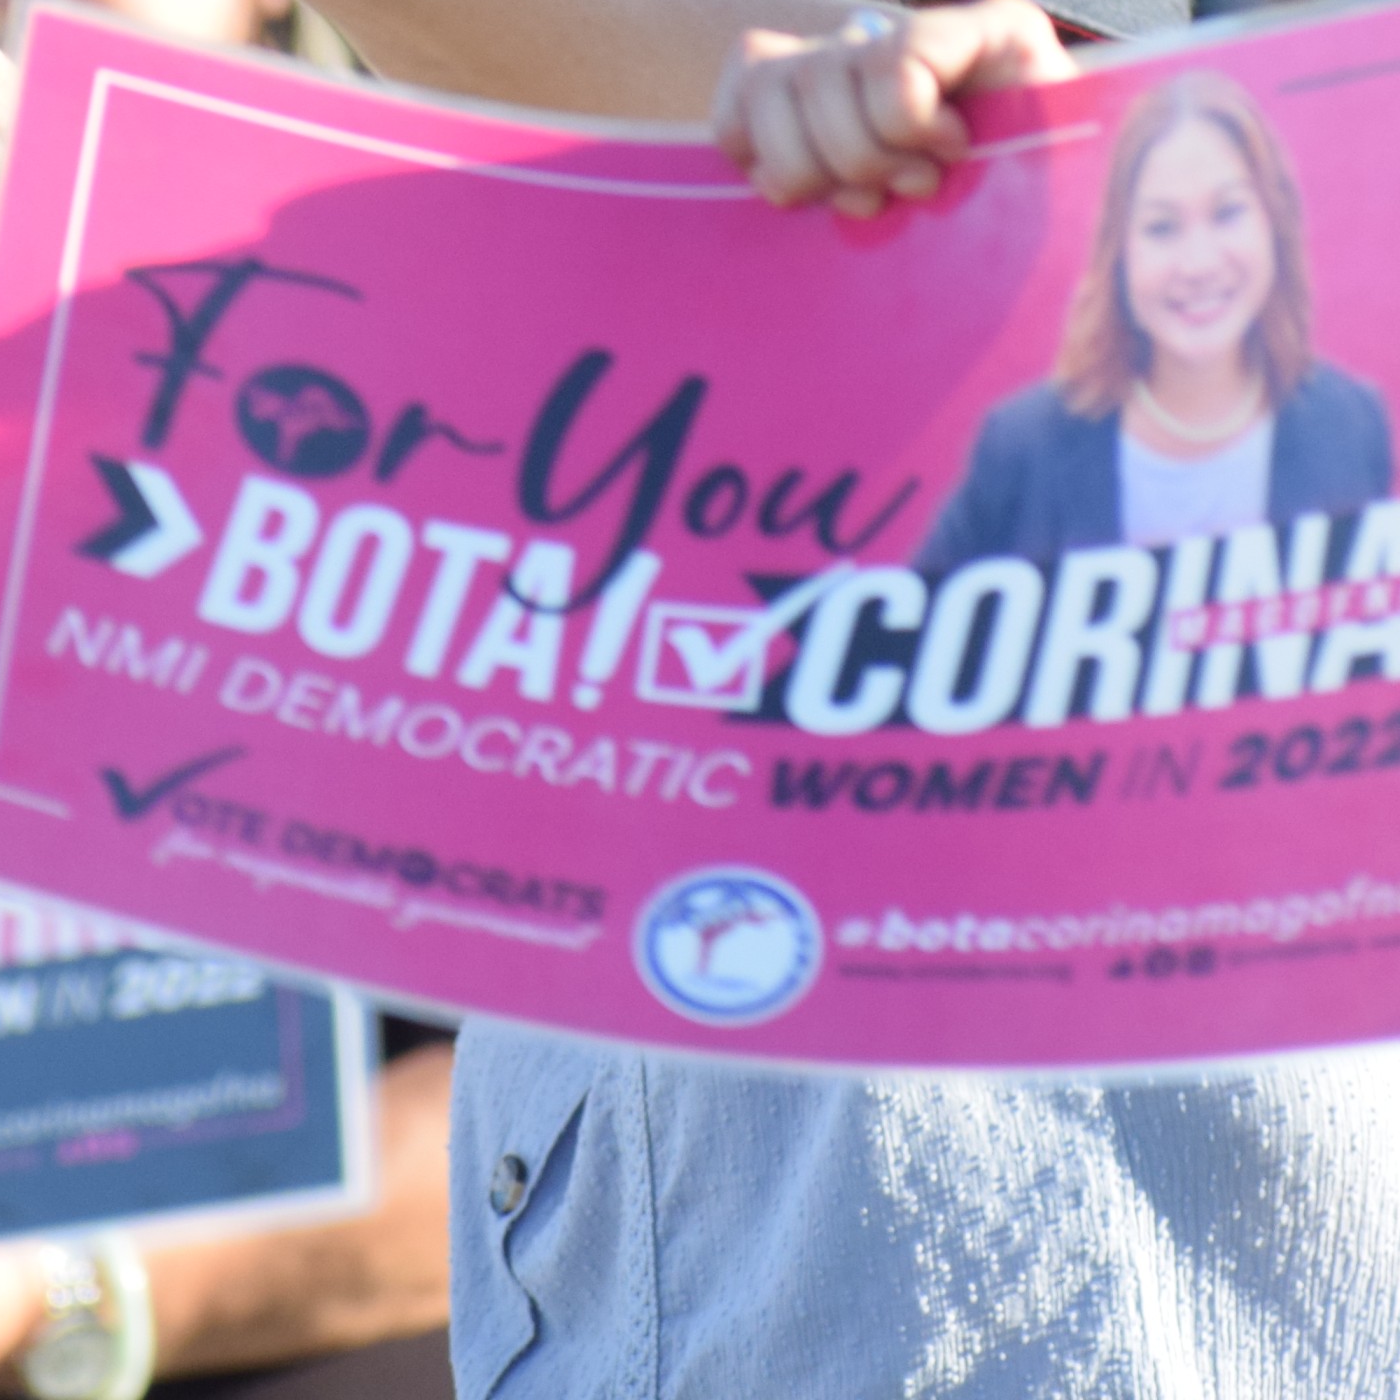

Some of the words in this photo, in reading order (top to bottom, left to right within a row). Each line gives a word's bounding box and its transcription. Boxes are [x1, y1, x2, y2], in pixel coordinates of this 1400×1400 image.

[123, 256, 505, 485] For
[502, 346, 922, 616] You
[196, 470, 662, 712] BOTA!
[46, 606, 211, 695] NMI
[216, 656, 753, 809] DEMOCRATIC
[768, 750, 1108, 815] WOMEN
[1120, 742, 1206, 802] IN
[280, 816, 606, 923] DEMOCRATS
[108, 958, 269, 1021] 2022
